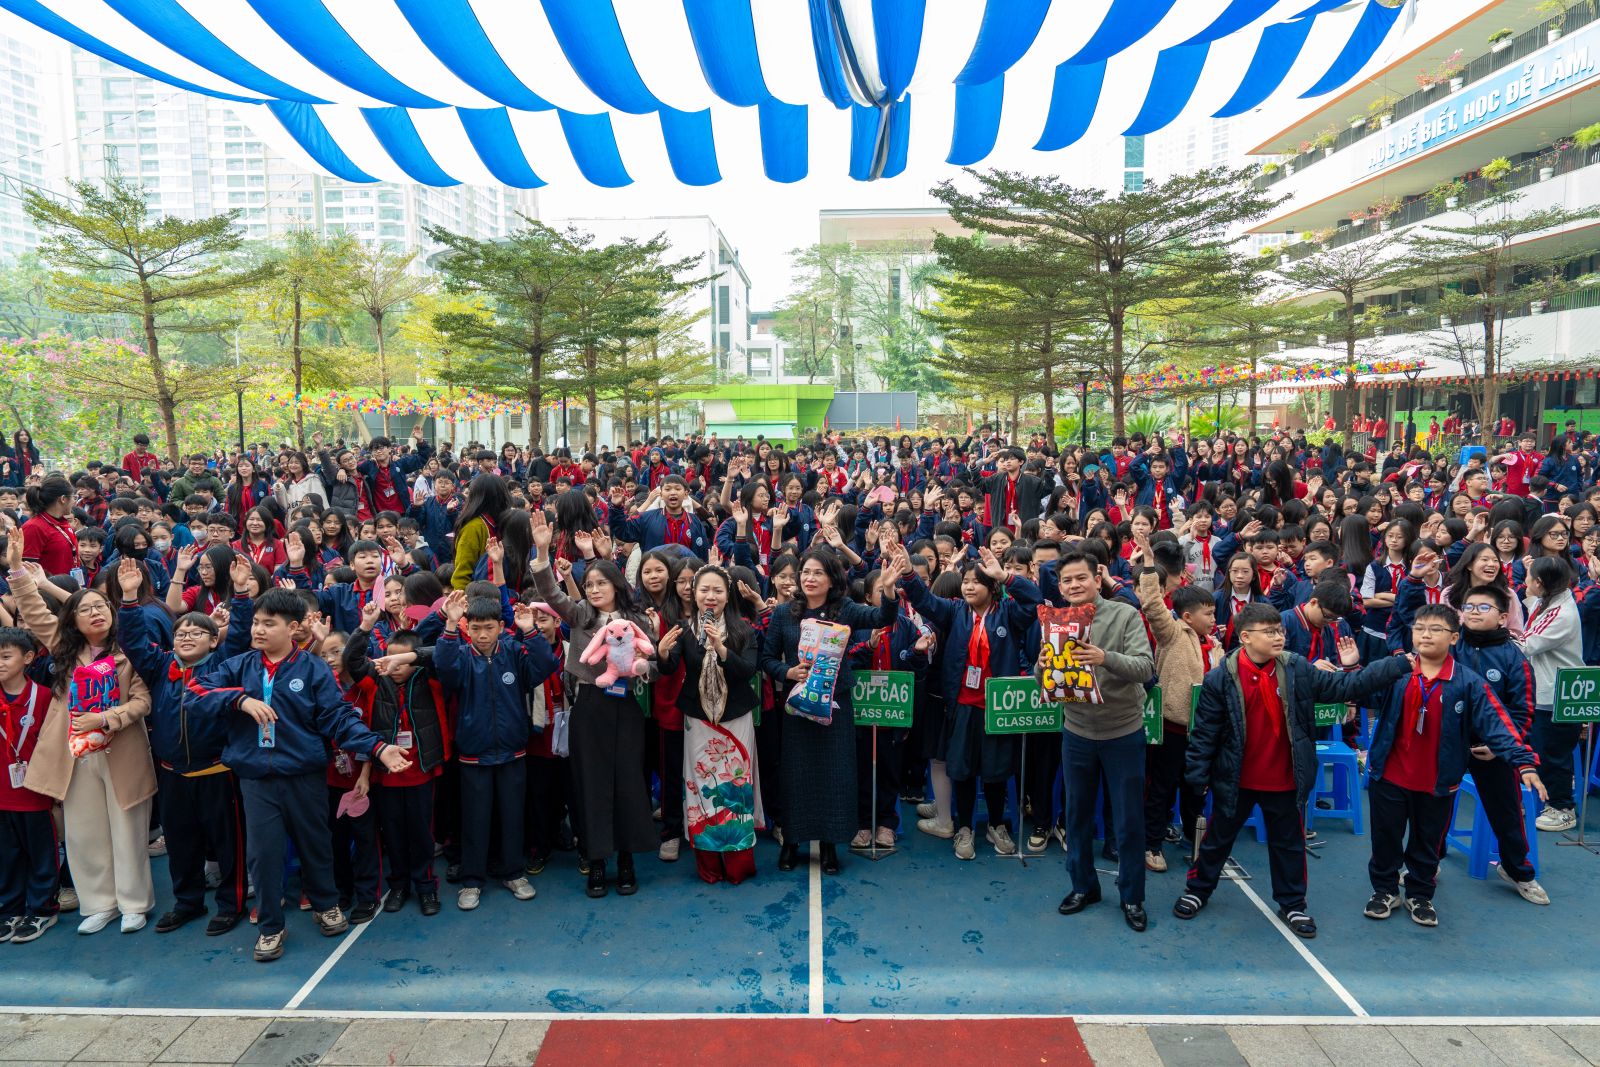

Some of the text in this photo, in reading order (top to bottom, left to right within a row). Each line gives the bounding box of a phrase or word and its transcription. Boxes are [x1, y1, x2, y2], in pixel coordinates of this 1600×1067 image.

[1368, 45, 1595, 168] HỌC ĐỂ BIẾT, HỌC ĐỂ LÀM,
[852, 676, 876, 701] ỚP
[880, 682, 909, 703] 6A6
[1560, 674, 1596, 700] LỚP
[993, 685, 1026, 711] LỚP
[853, 707, 905, 720] LASS 6A6
[1318, 709, 1336, 720] 6A2
[1563, 705, 1600, 717] CLASS
[996, 715, 1055, 728] CLASS 6A5
